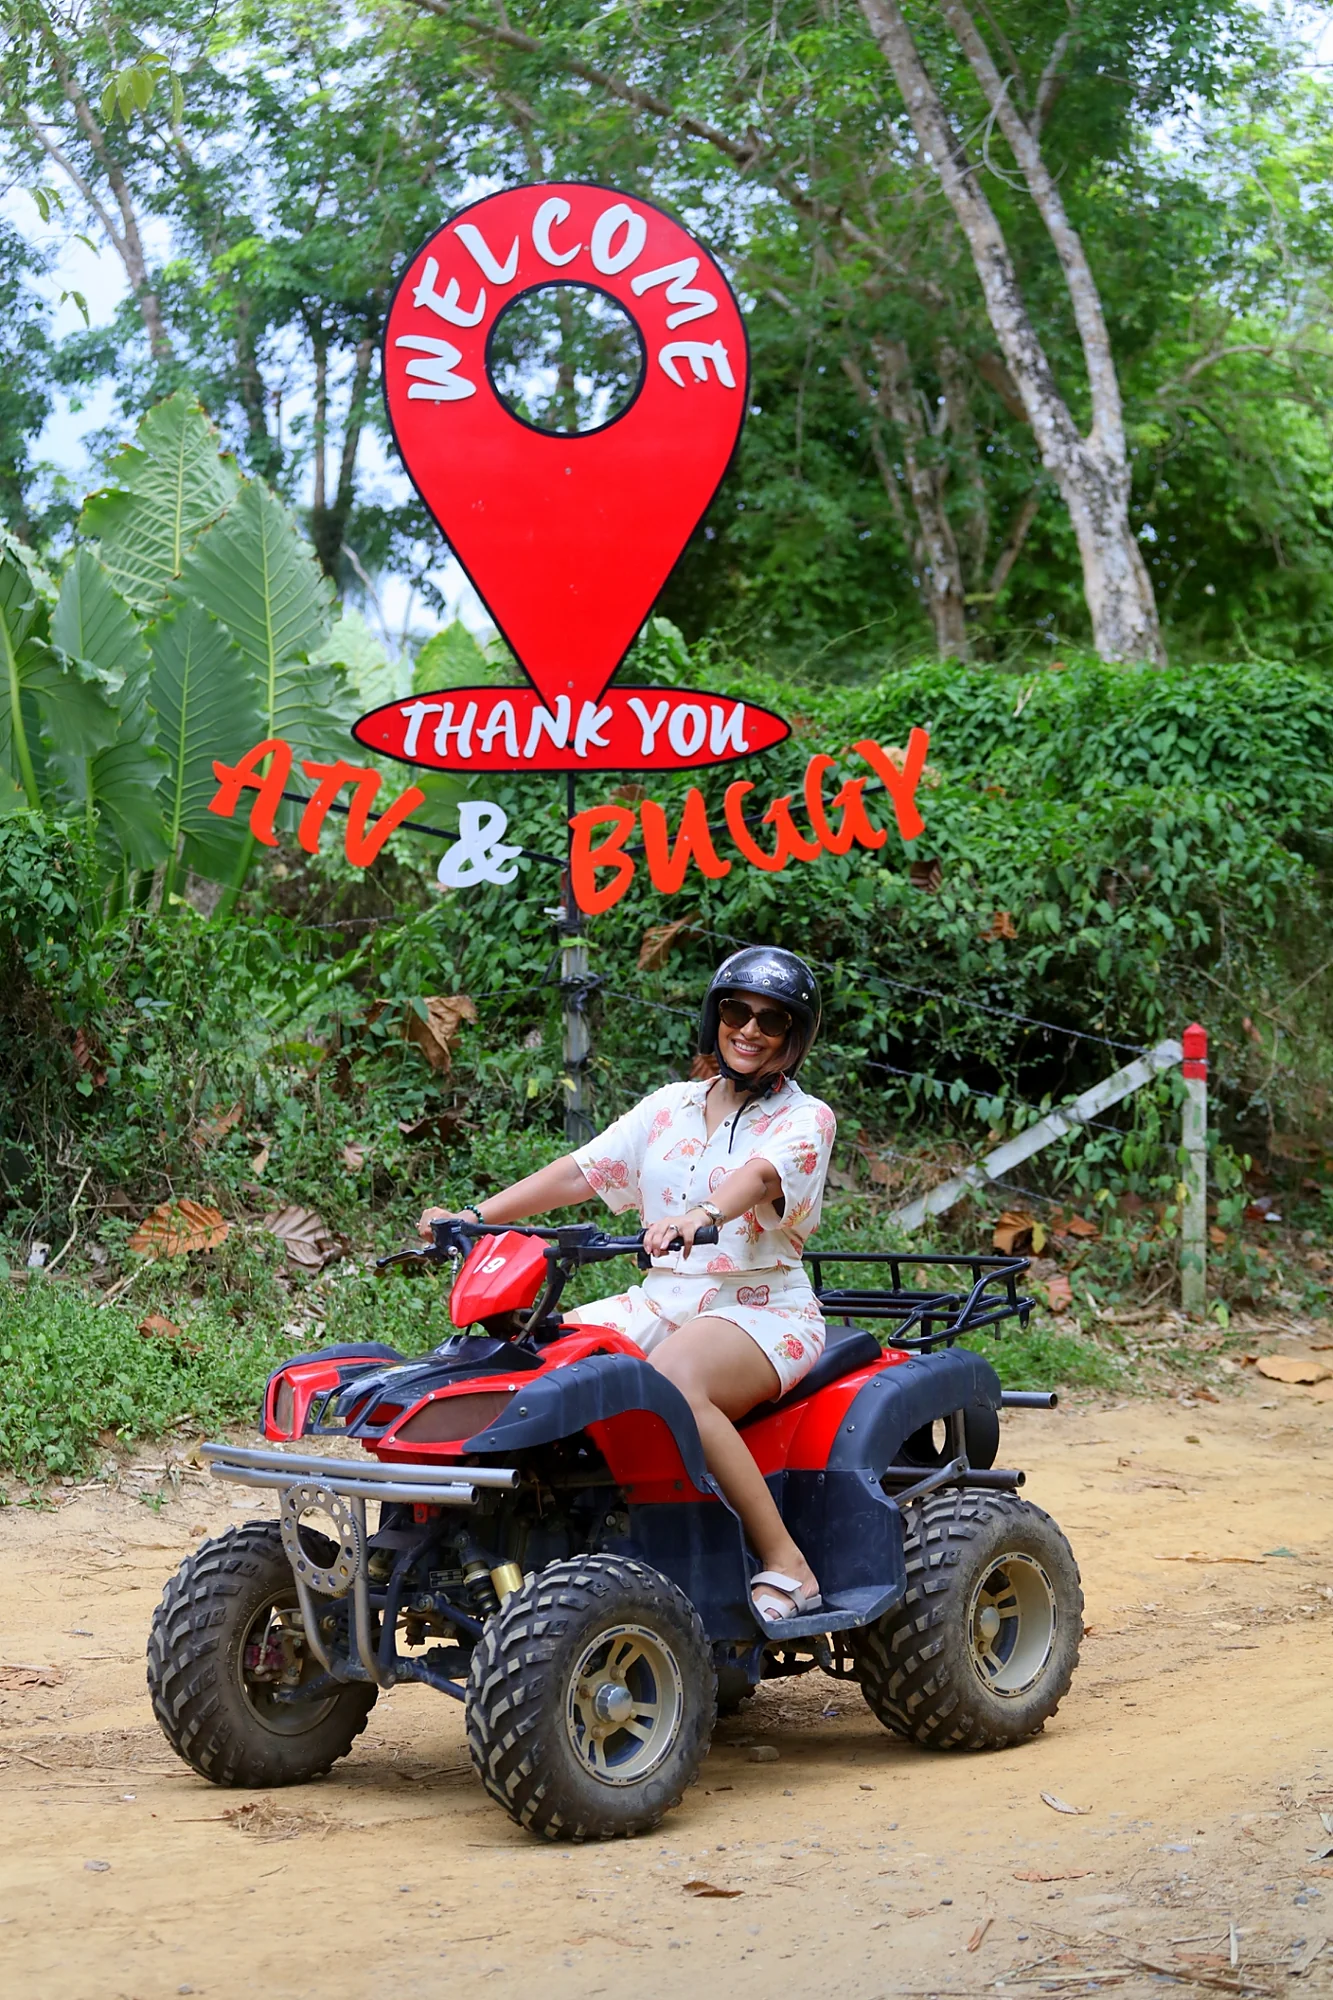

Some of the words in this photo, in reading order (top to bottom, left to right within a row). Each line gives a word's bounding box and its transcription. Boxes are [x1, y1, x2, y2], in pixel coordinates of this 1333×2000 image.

[395, 197, 736, 401] WELCOME
[402, 695, 612, 757] THANK
[627, 698, 748, 756] YOU
[208, 739, 425, 867] ATV
[437, 801, 522, 887] &
[569, 727, 929, 915] BUGGY
